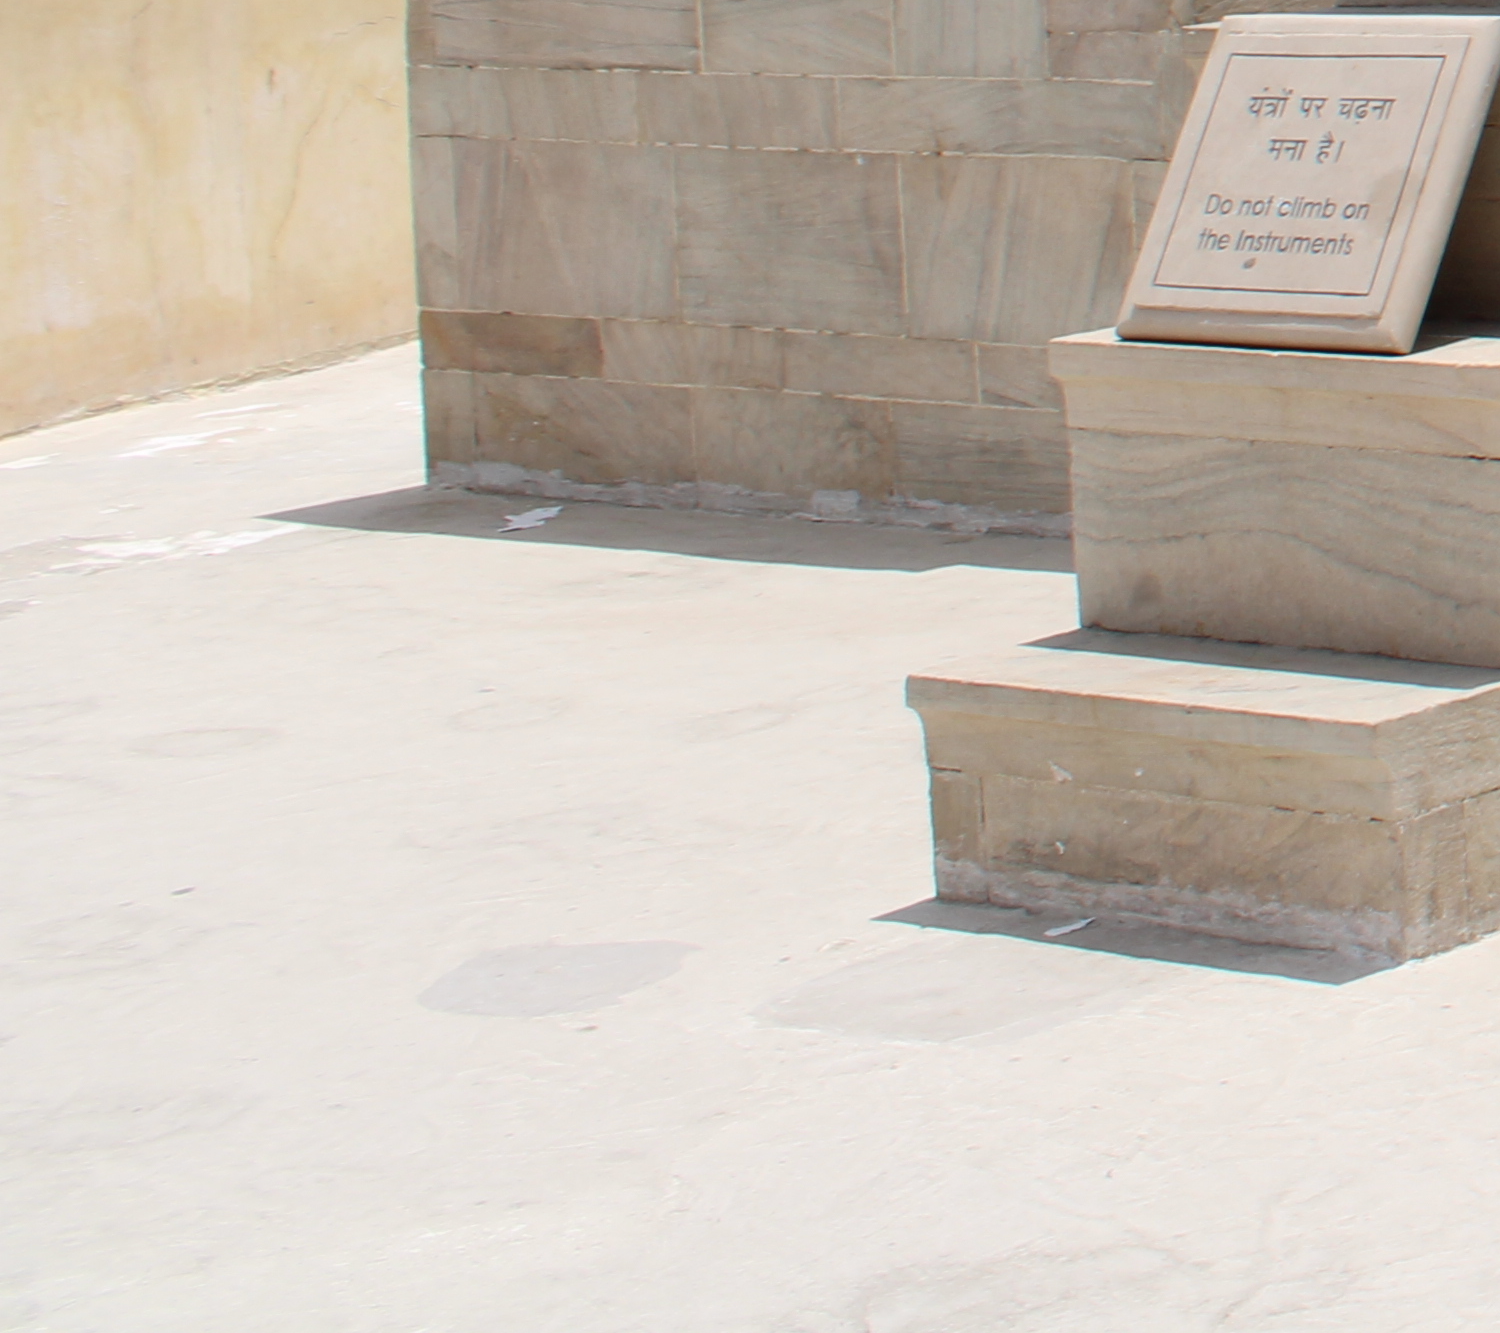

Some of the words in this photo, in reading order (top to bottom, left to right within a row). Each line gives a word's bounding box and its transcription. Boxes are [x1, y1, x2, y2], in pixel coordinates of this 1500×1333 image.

[1248, 87, 1295, 119] यंत्रों
[1300, 96, 1329, 119] पर
[1338, 97, 1397, 124] चढ़ना
[1267, 138, 1309, 162] मना
[1203, 193, 1233, 215] Do
[1236, 195, 1274, 217] not
[1276, 196, 1337, 219] climb
[1342, 202, 1371, 220] on
[1197, 227, 1230, 251] the
[1234, 229, 1355, 255] Instruments
